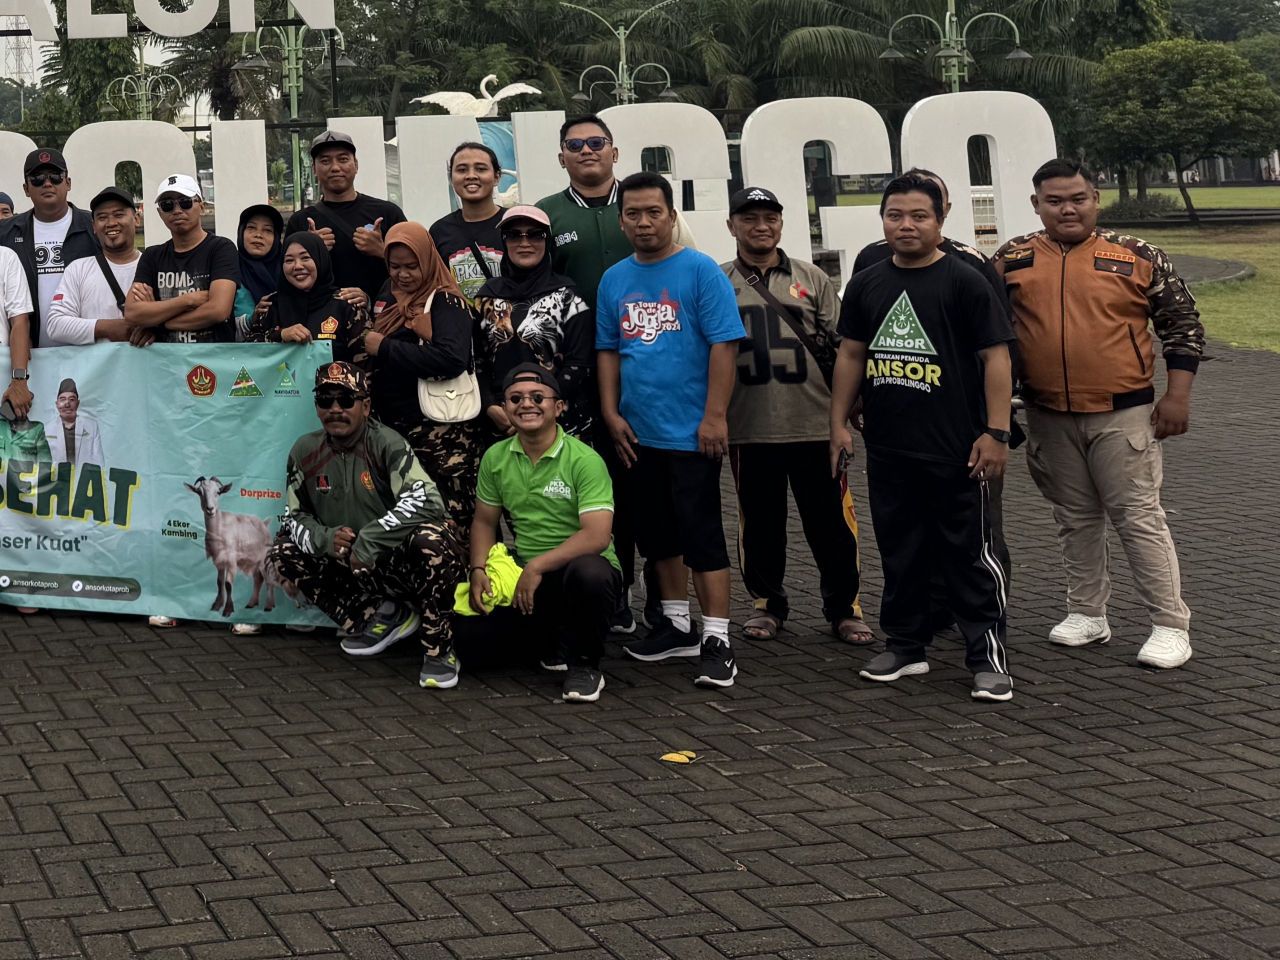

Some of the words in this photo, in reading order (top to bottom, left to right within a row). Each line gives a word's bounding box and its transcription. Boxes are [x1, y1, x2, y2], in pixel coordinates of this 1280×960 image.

[35, 245, 65, 266] 93
[1095, 251, 1135, 262] BANSER
[638, 301, 659, 309] Tour
[622, 302, 678, 343] Jogja
[662, 322, 681, 331] 2024
[878, 336, 927, 350] ANSOR
[874, 352, 901, 361] GERAKAN
[900, 355, 930, 364] PEMUDA
[866, 359, 942, 387] ANSOR
[885, 377, 931, 393] PROBOLINGGO
[240, 487, 282, 500] Dorprize
[542, 486, 572, 495] ANSOR
[167, 519, 172, 527] 4
[172, 520, 190, 528] Ekor
[161, 528, 198, 540] Kambing
[36, 535, 88, 553] Kuat"
[12, 579, 59, 589] ansorkotaprob
[84, 584, 130, 593] ansorkotaprob
